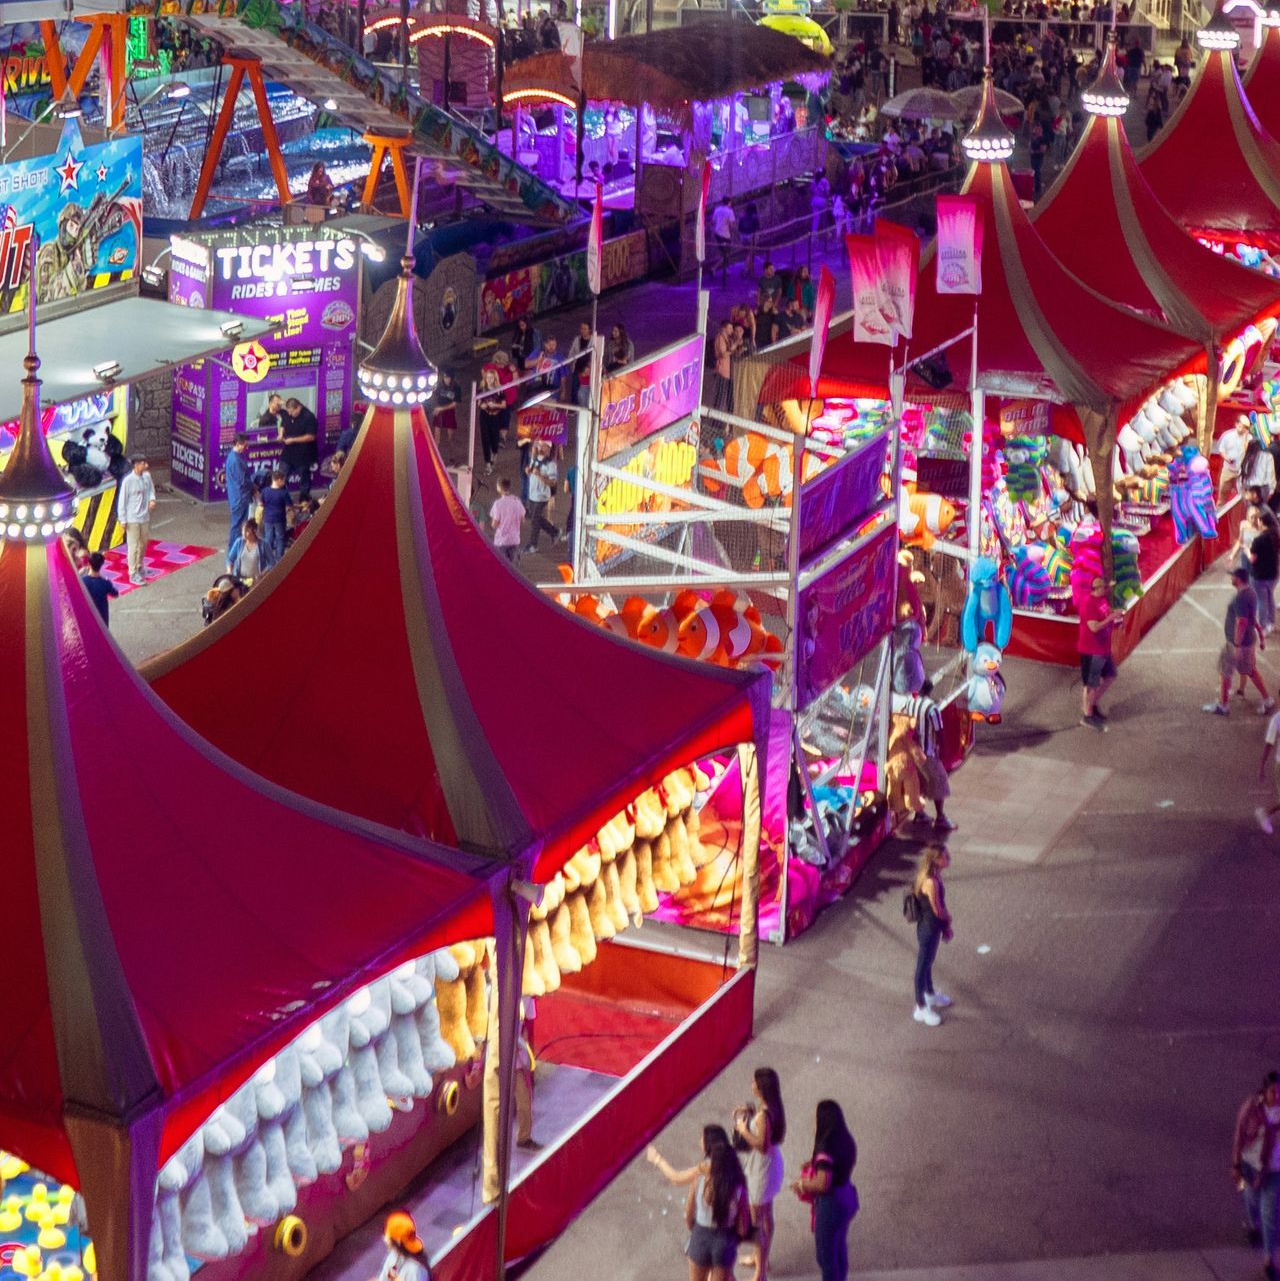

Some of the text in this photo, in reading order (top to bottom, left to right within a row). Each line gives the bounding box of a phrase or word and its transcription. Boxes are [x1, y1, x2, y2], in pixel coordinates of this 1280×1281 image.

[3, 55, 67, 96] RIVE
[12, 169, 49, 194] SHOT!
[216, 238, 356, 280] TICKETS
[231, 282, 274, 300] RIDES
[276, 281, 288, 297] &
[172, 441, 205, 471] TICKETS
